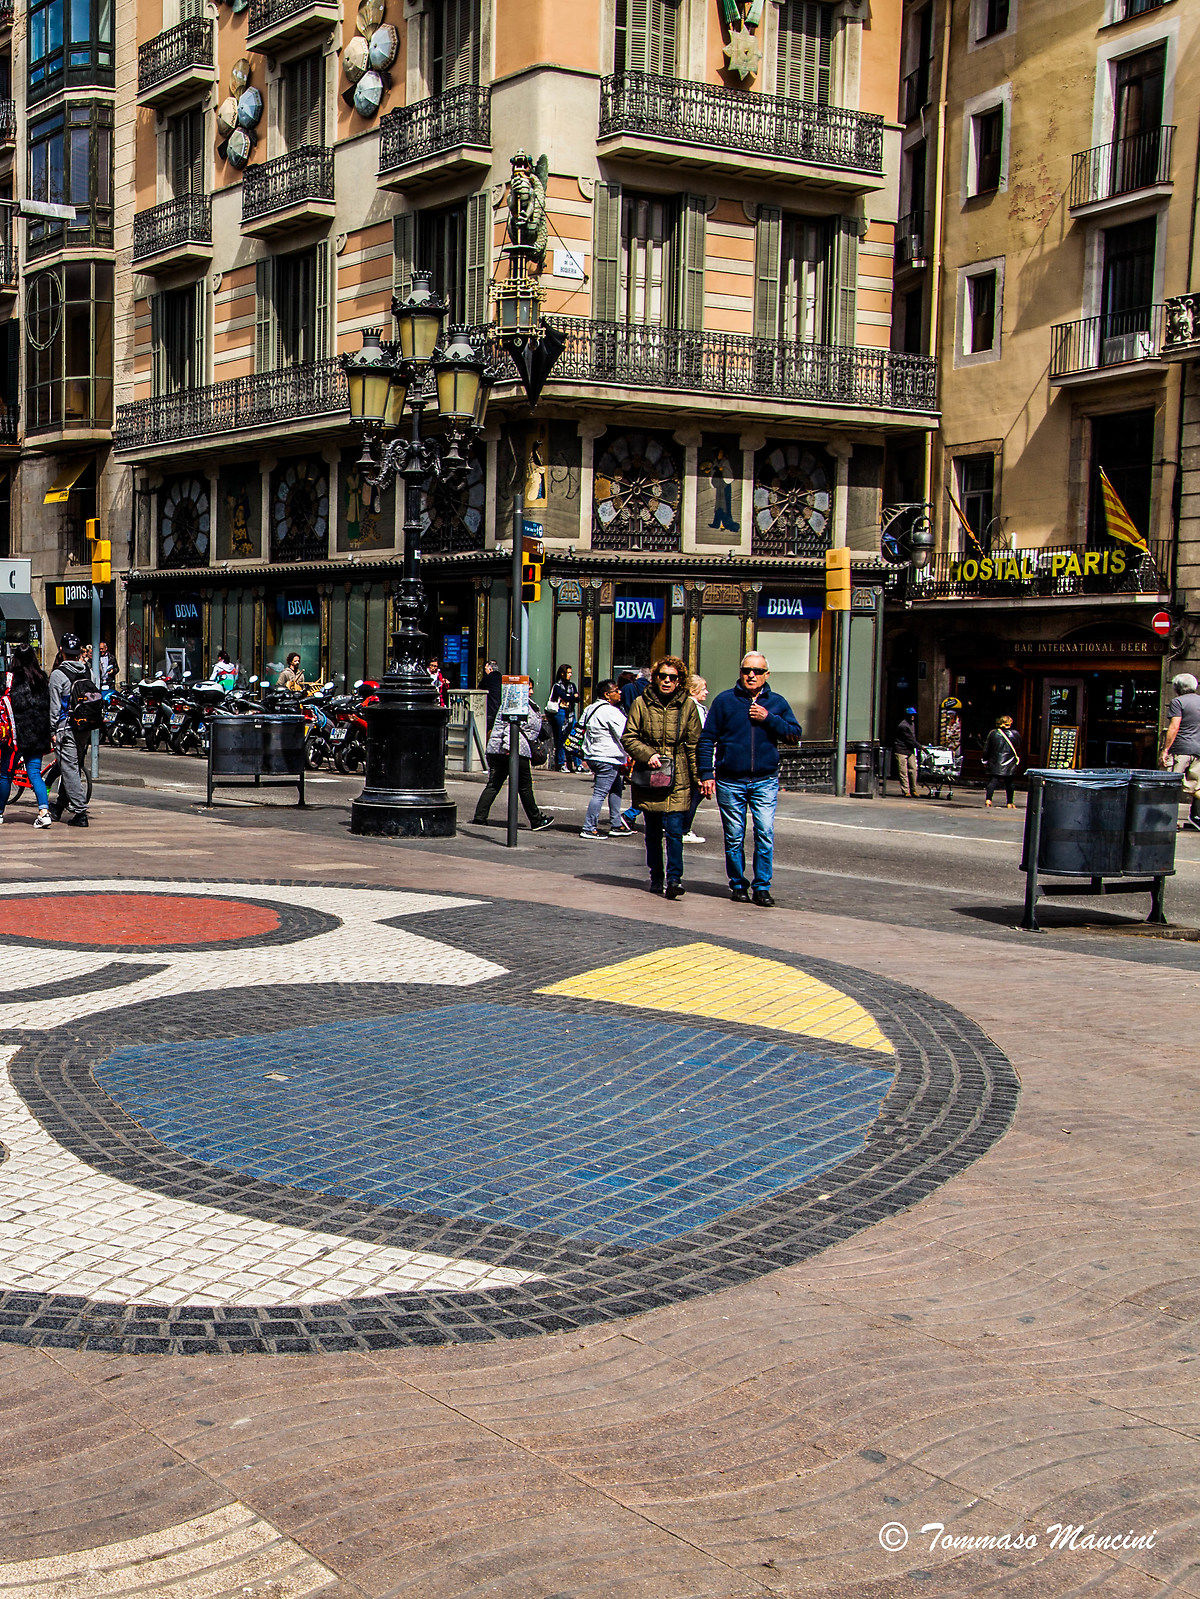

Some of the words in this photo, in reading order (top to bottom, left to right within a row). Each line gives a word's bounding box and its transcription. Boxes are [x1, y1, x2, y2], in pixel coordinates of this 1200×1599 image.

[950, 557, 1034, 582] HOSTAL
[1052, 550, 1127, 577] PARIS
[65, 585, 87, 605] pans
[175, 603, 198, 618] BBVA
[287, 600, 314, 615] BBVA
[615, 601, 656, 620] BBVA
[767, 598, 804, 616] BBVA
[1014, 643, 1033, 652] BAR
[1039, 643, 1115, 652] INTERNATIONAL
[1121, 642, 1148, 652] BEER
